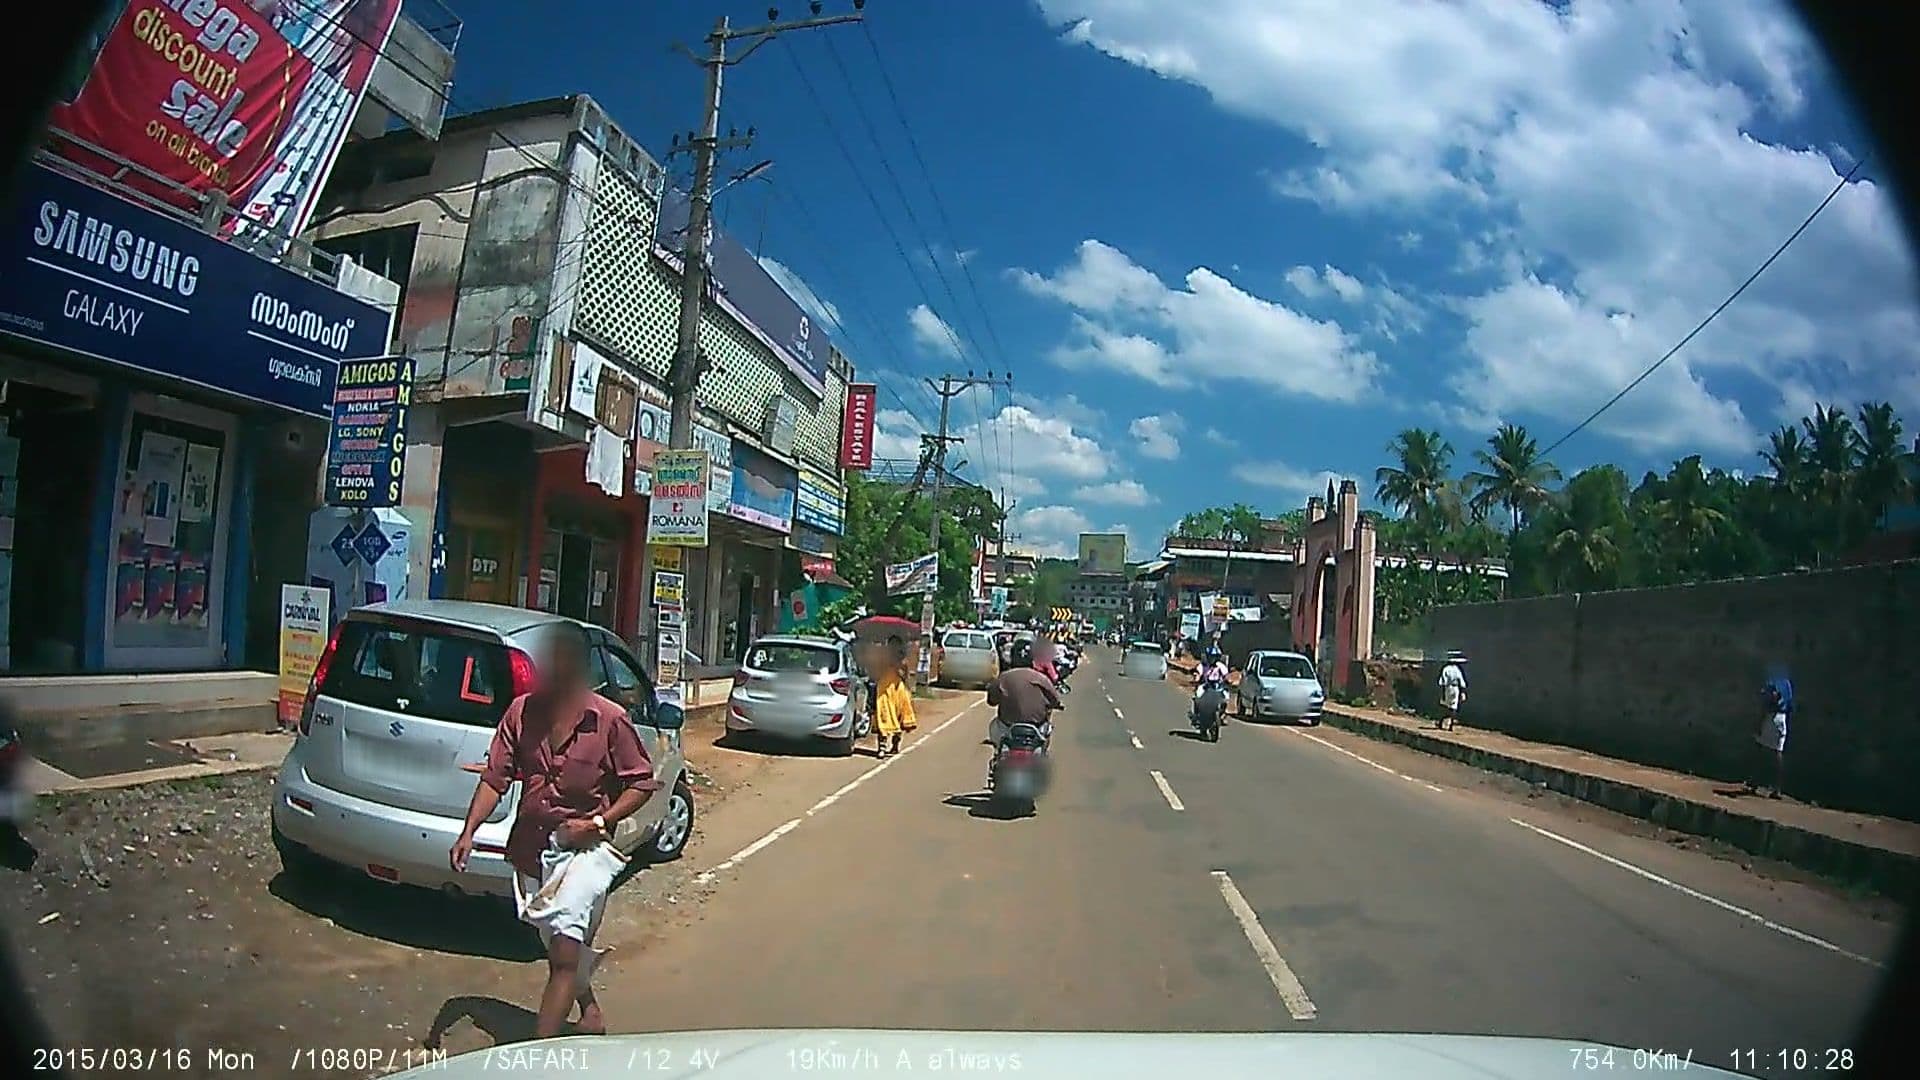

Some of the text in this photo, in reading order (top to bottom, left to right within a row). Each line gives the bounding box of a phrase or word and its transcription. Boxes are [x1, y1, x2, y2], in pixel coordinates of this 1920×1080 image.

[133, 7, 237, 99] discount
[160, 79, 248, 157] sale
[146, 120, 167, 144] on
[168, 131, 190, 157] all
[34, 200, 200, 296] SAMSUNG
[63, 289, 144, 336] GALAXY
[251, 292, 355, 352] സാംസംഗ്
[340, 361, 397, 384] AMIGOS
[347, 402, 380, 412] NOKIA
[356, 426, 384, 437] SONY
[340, 490, 368, 500] XOLO
[652, 515, 705, 527] ROMANA
[472, 558, 498, 574] DTP
